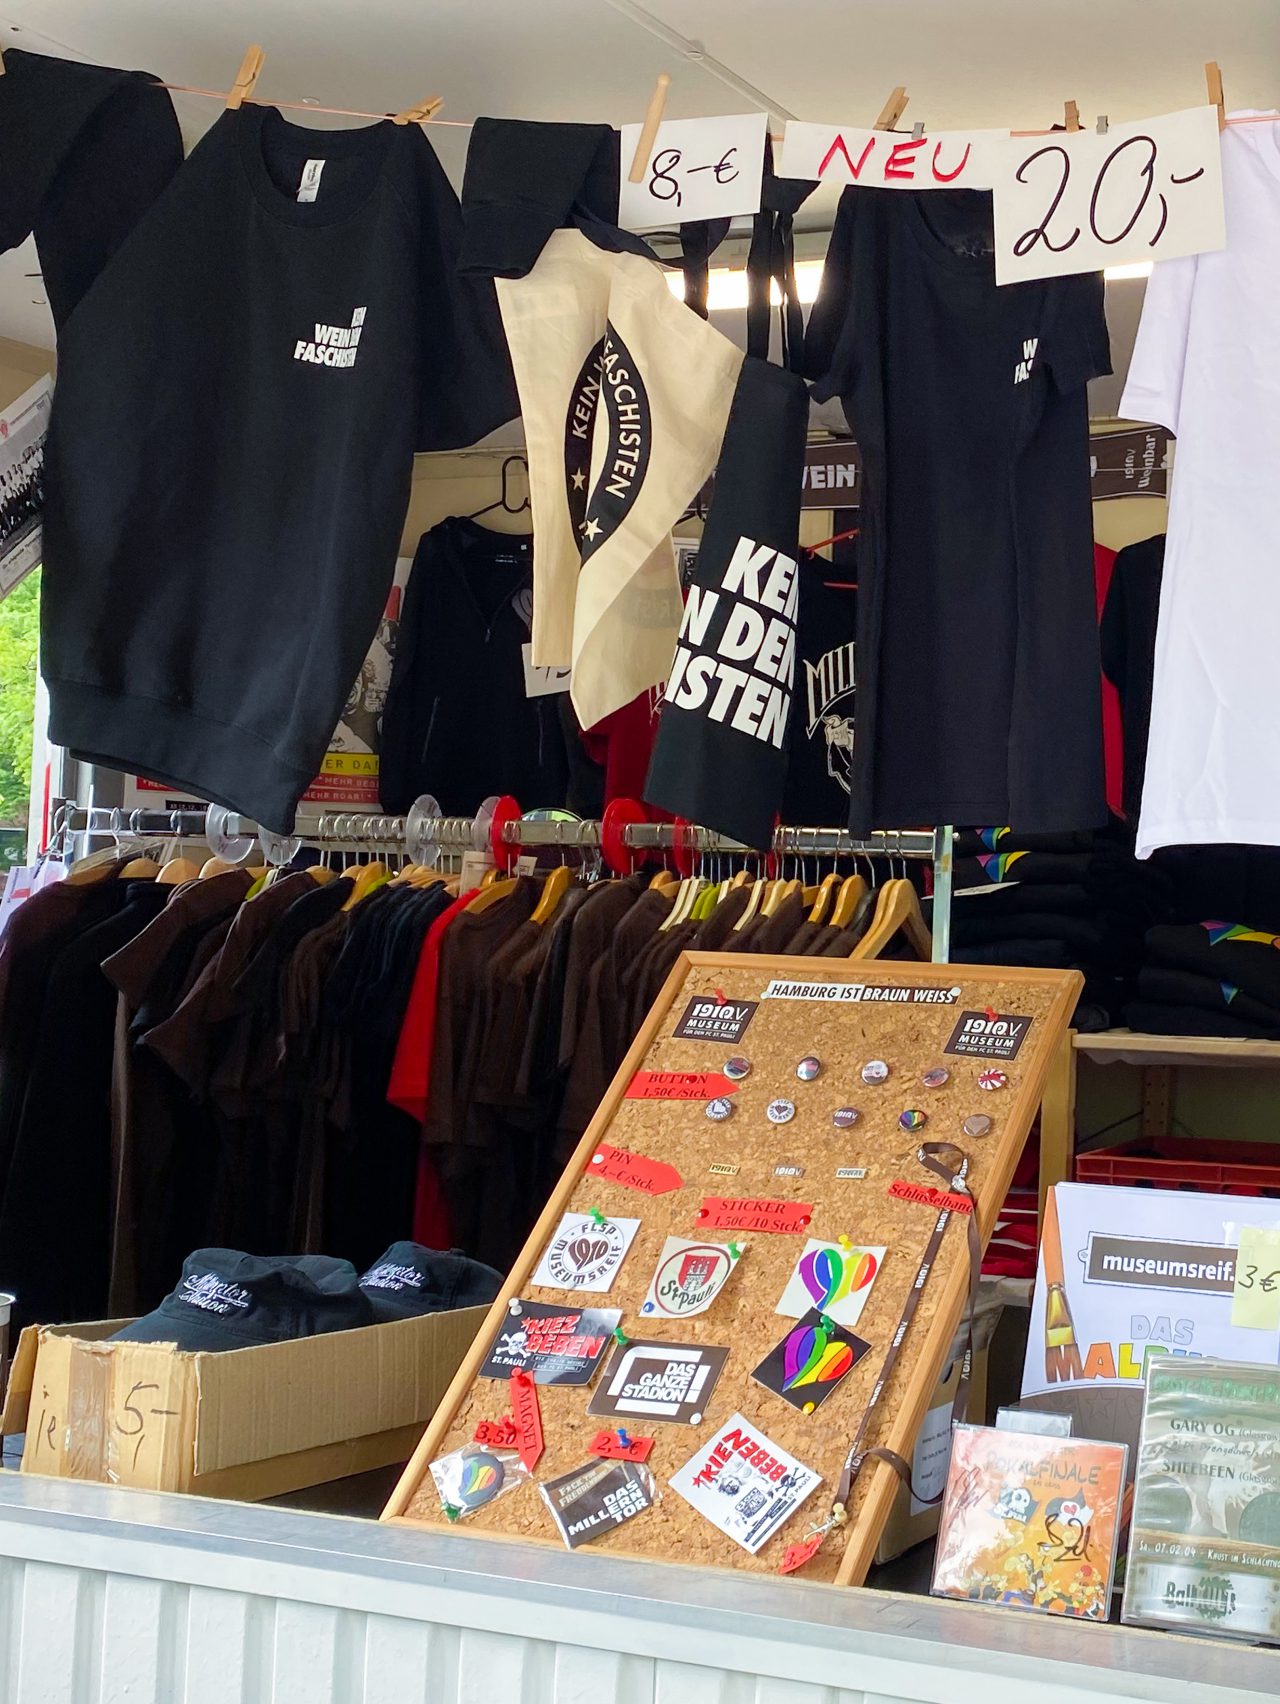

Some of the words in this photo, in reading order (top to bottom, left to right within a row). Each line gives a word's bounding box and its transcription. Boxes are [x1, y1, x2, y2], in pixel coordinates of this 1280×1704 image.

[817, 133, 971, 182] NEU
[572, 375, 602, 440] KEIN
[1138, 434, 1156, 489] Weinbar
[770, 984, 837, 998] HAMBURG
[841, 987, 862, 999] IST
[862, 988, 910, 1002] BRAUN
[913, 989, 954, 1003] WEISS
[686, 1018, 741, 1032] MUSEUM
[959, 1035, 1014, 1048] MUSEUM
[649, 1073, 709, 1085] BUTTN
[608, 1150, 633, 1165] PIN
[720, 1200, 786, 1214] STICKER
[678, 1282, 716, 1310] Pauli
[526, 1315, 581, 1335] KIEZ
[1130, 1314, 1195, 1345] DAS
[525, 1333, 606, 1360] BEBEN
[491, 1355, 502, 1365] ST.
[502, 1356, 527, 1367] PAULI
[664, 1362, 696, 1377] DAS
[640, 1372, 692, 1388] GANZE
[621, 1384, 686, 1402] STADION
[517, 1389, 538, 1451] MAGNET
[1170, 1417, 1208, 1433] GARY
[1213, 1423, 1236, 1437] OG
[475, 1424, 517, 1445] 3,50
[602, 1479, 639, 1504] DAS
[610, 1496, 649, 1523] TOR
